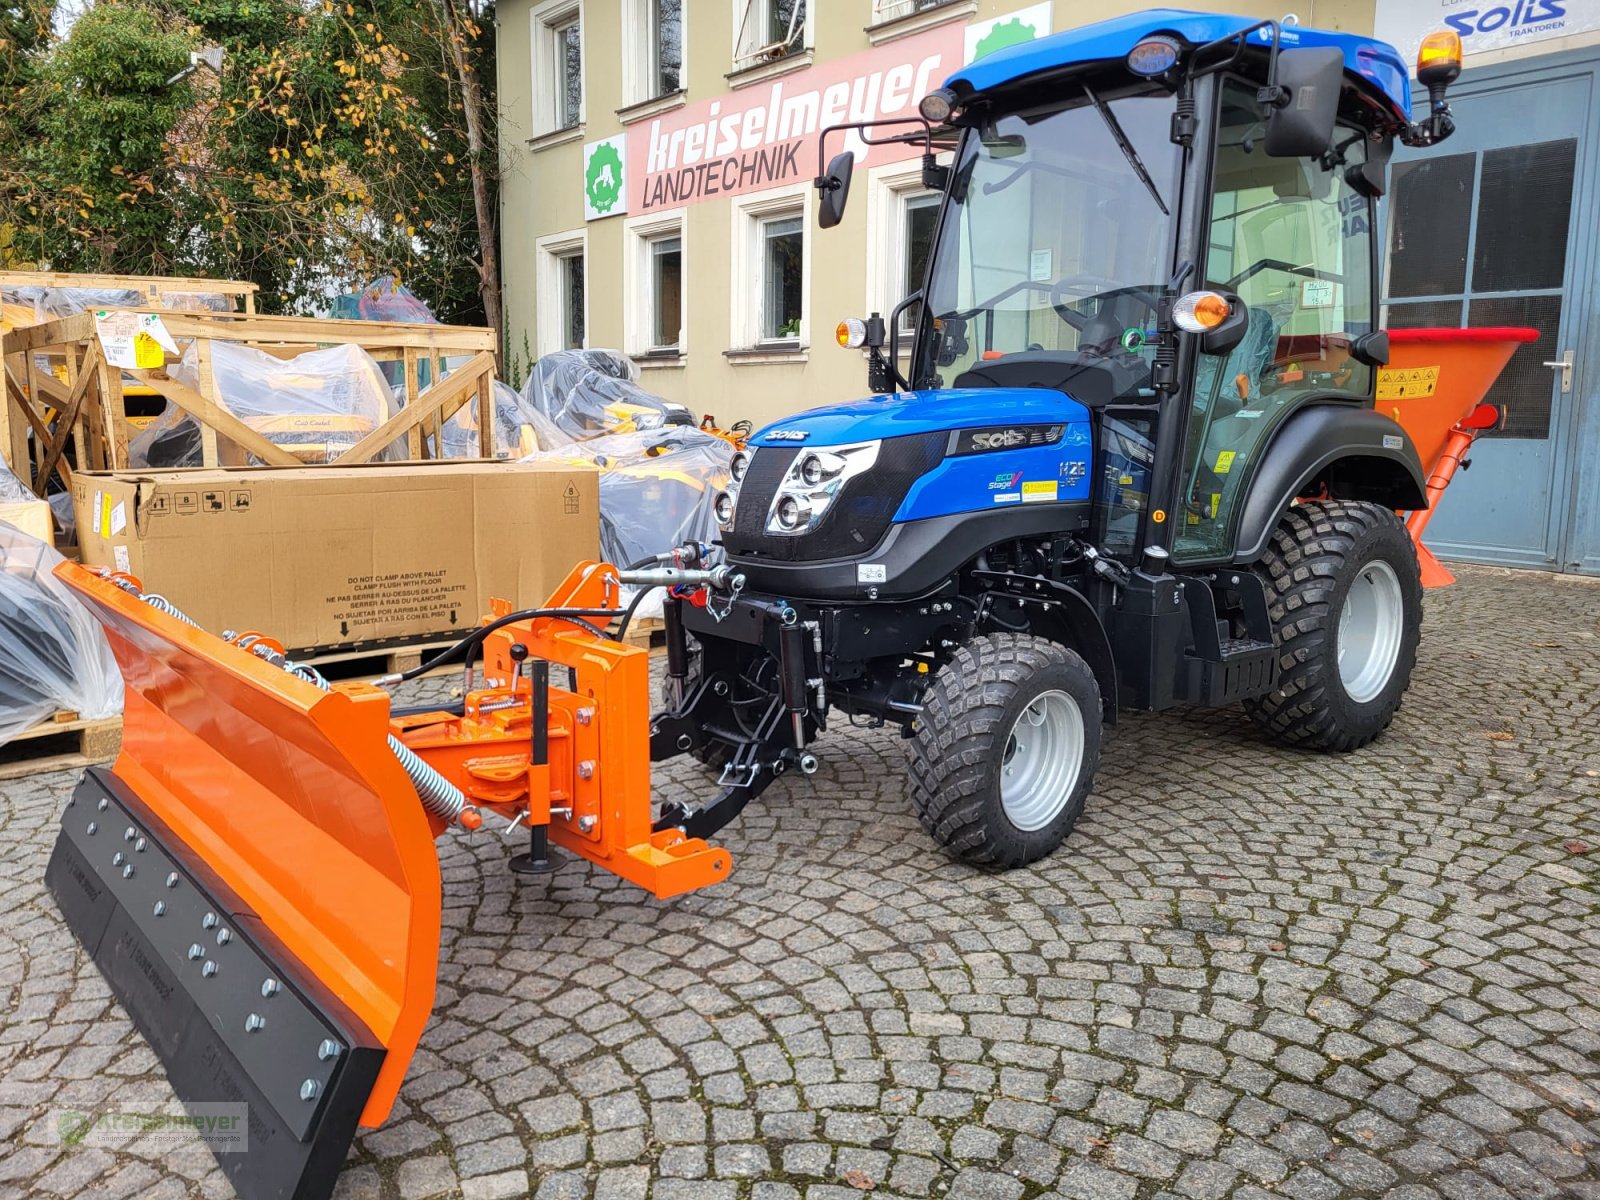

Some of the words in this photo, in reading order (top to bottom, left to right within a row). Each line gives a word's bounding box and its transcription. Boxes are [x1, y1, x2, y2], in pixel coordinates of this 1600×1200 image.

[1509, 21, 1566, 38] TRAKTOREN
[646, 54, 941, 175] kreiselmeyer
[642, 140, 803, 209] LANDTECHNIK
[382, 590, 419, 598] AU-DESSUS
[413, 594, 446, 603] PLANCHER
